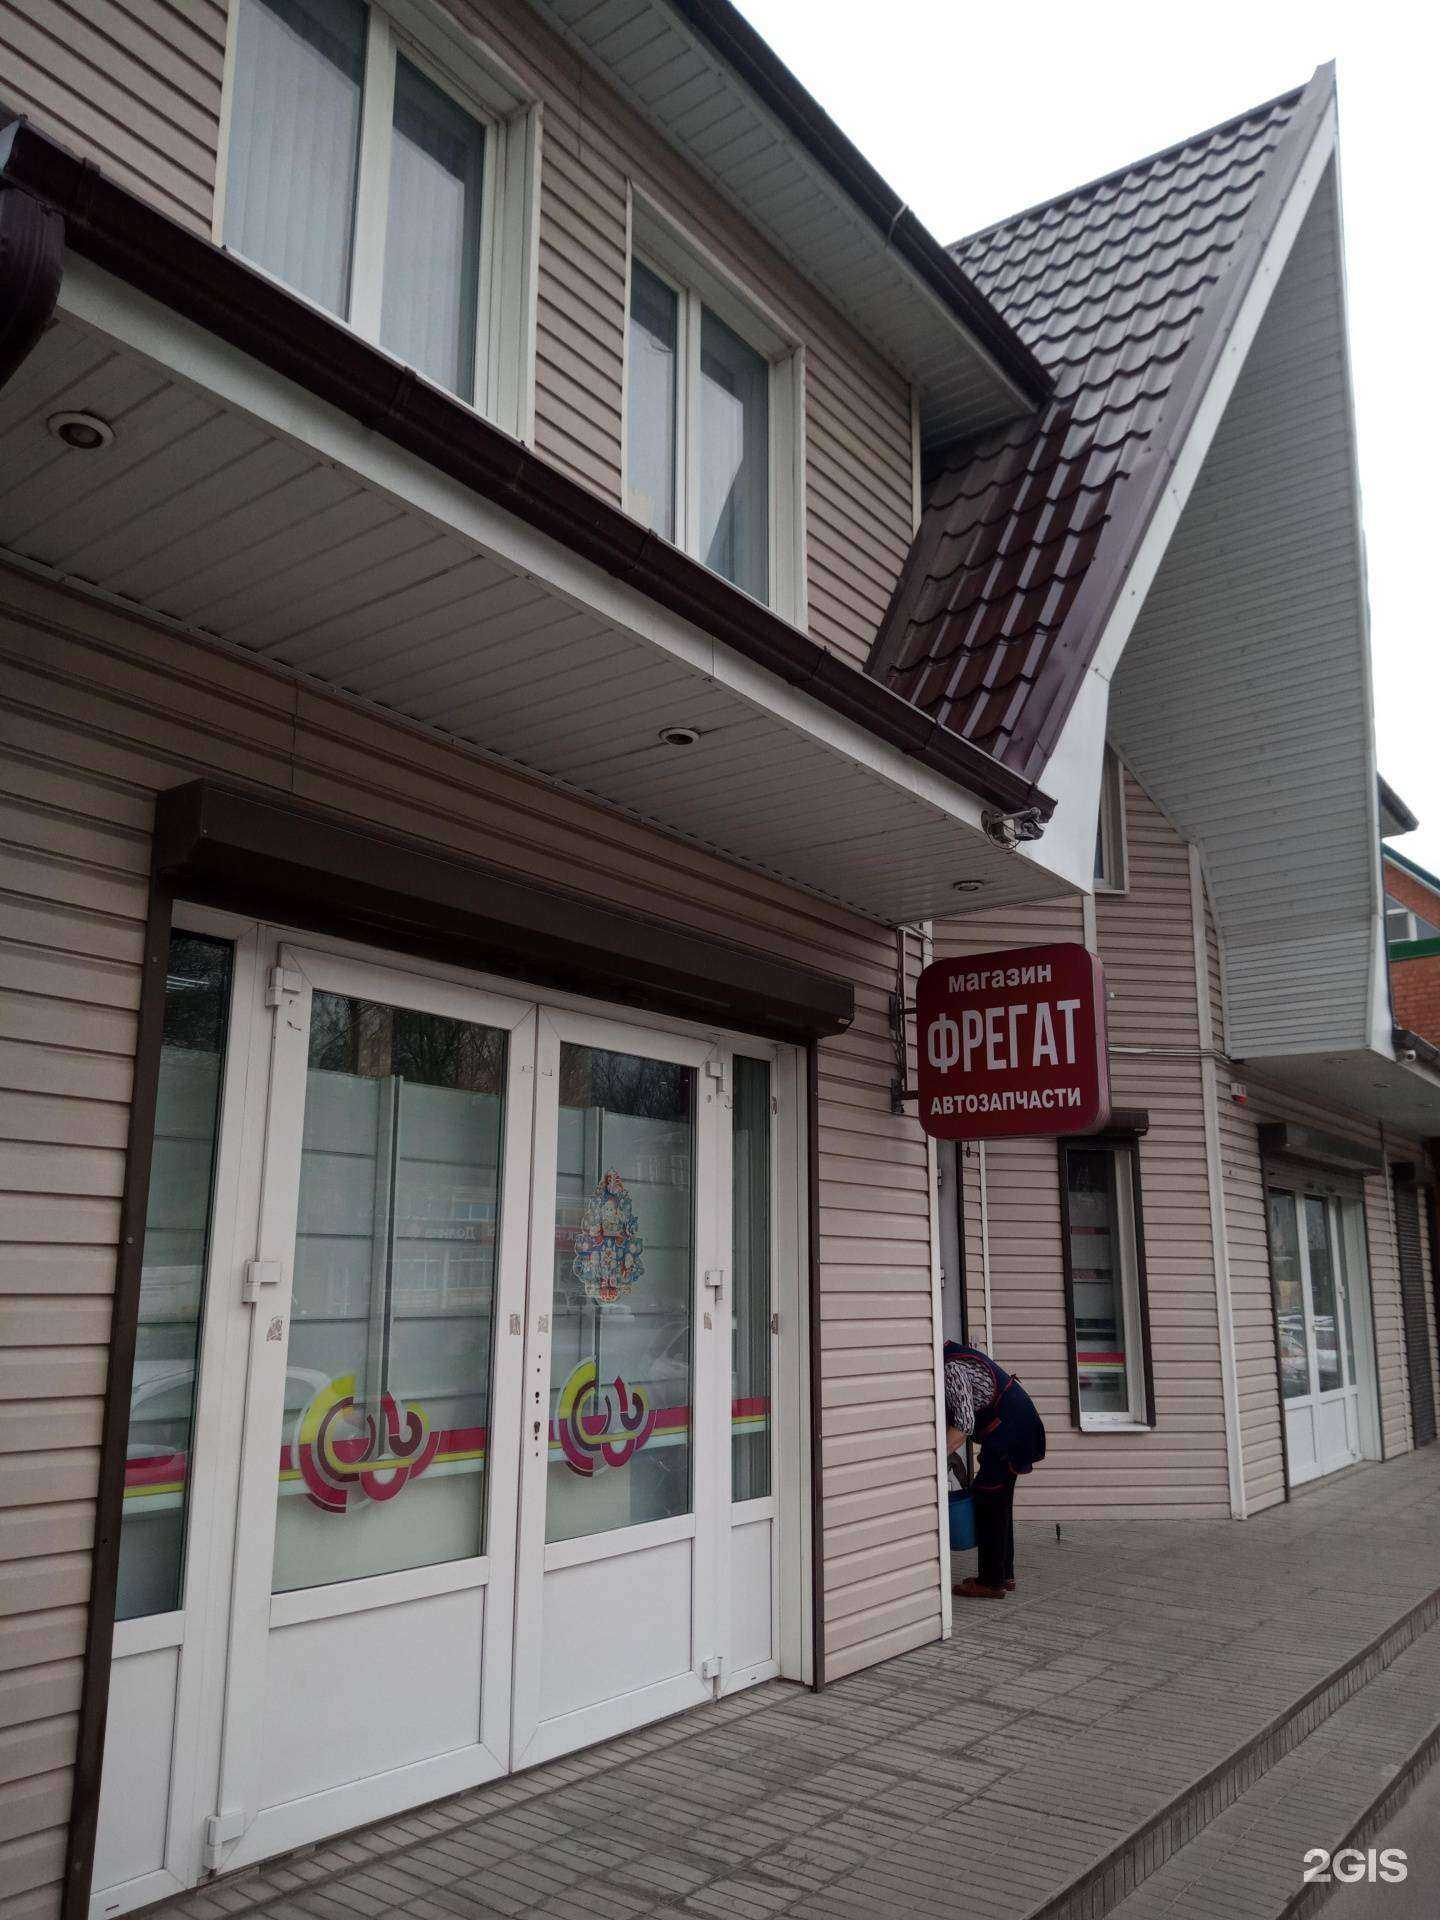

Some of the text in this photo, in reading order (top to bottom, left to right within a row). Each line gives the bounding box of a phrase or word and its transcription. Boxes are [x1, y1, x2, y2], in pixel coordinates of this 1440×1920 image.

[948, 963, 1052, 993] магазин
[927, 998, 1081, 1074] ФРЕГАТ
[930, 1087, 1081, 1115] АВТОЗАПЧАСТИ
